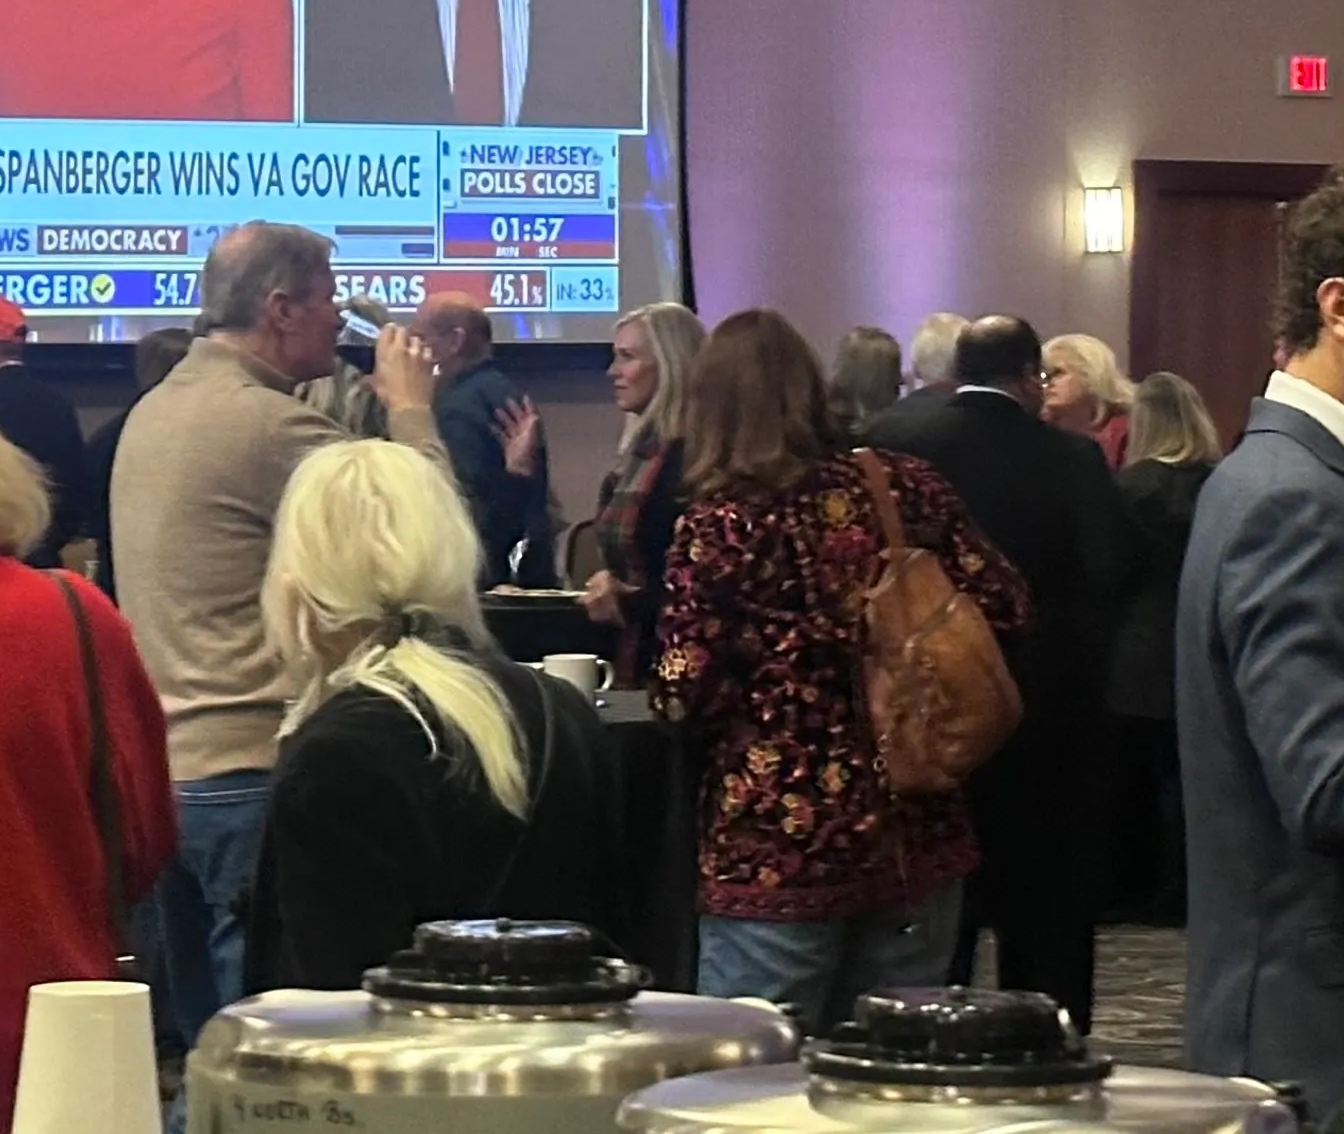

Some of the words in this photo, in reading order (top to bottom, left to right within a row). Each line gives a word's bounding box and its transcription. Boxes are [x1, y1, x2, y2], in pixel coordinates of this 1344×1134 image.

[470, 145, 519, 164] NEW
[525, 146, 592, 165] JERSEY
[168, 151, 240, 196] WINS
[246, 152, 285, 197] VA
[291, 153, 352, 198] GOV
[358, 154, 421, 198] RACE
[464, 172, 527, 194] POLLS
[532, 173, 596, 195] CLOSE
[42, 228, 182, 251] DEMOCRACY
[491, 217, 565, 243] 01:57
[538, 247, 558, 258] SEC
[332, 275, 426, 304] SEARS
[557, 284, 576, 300] IN:
